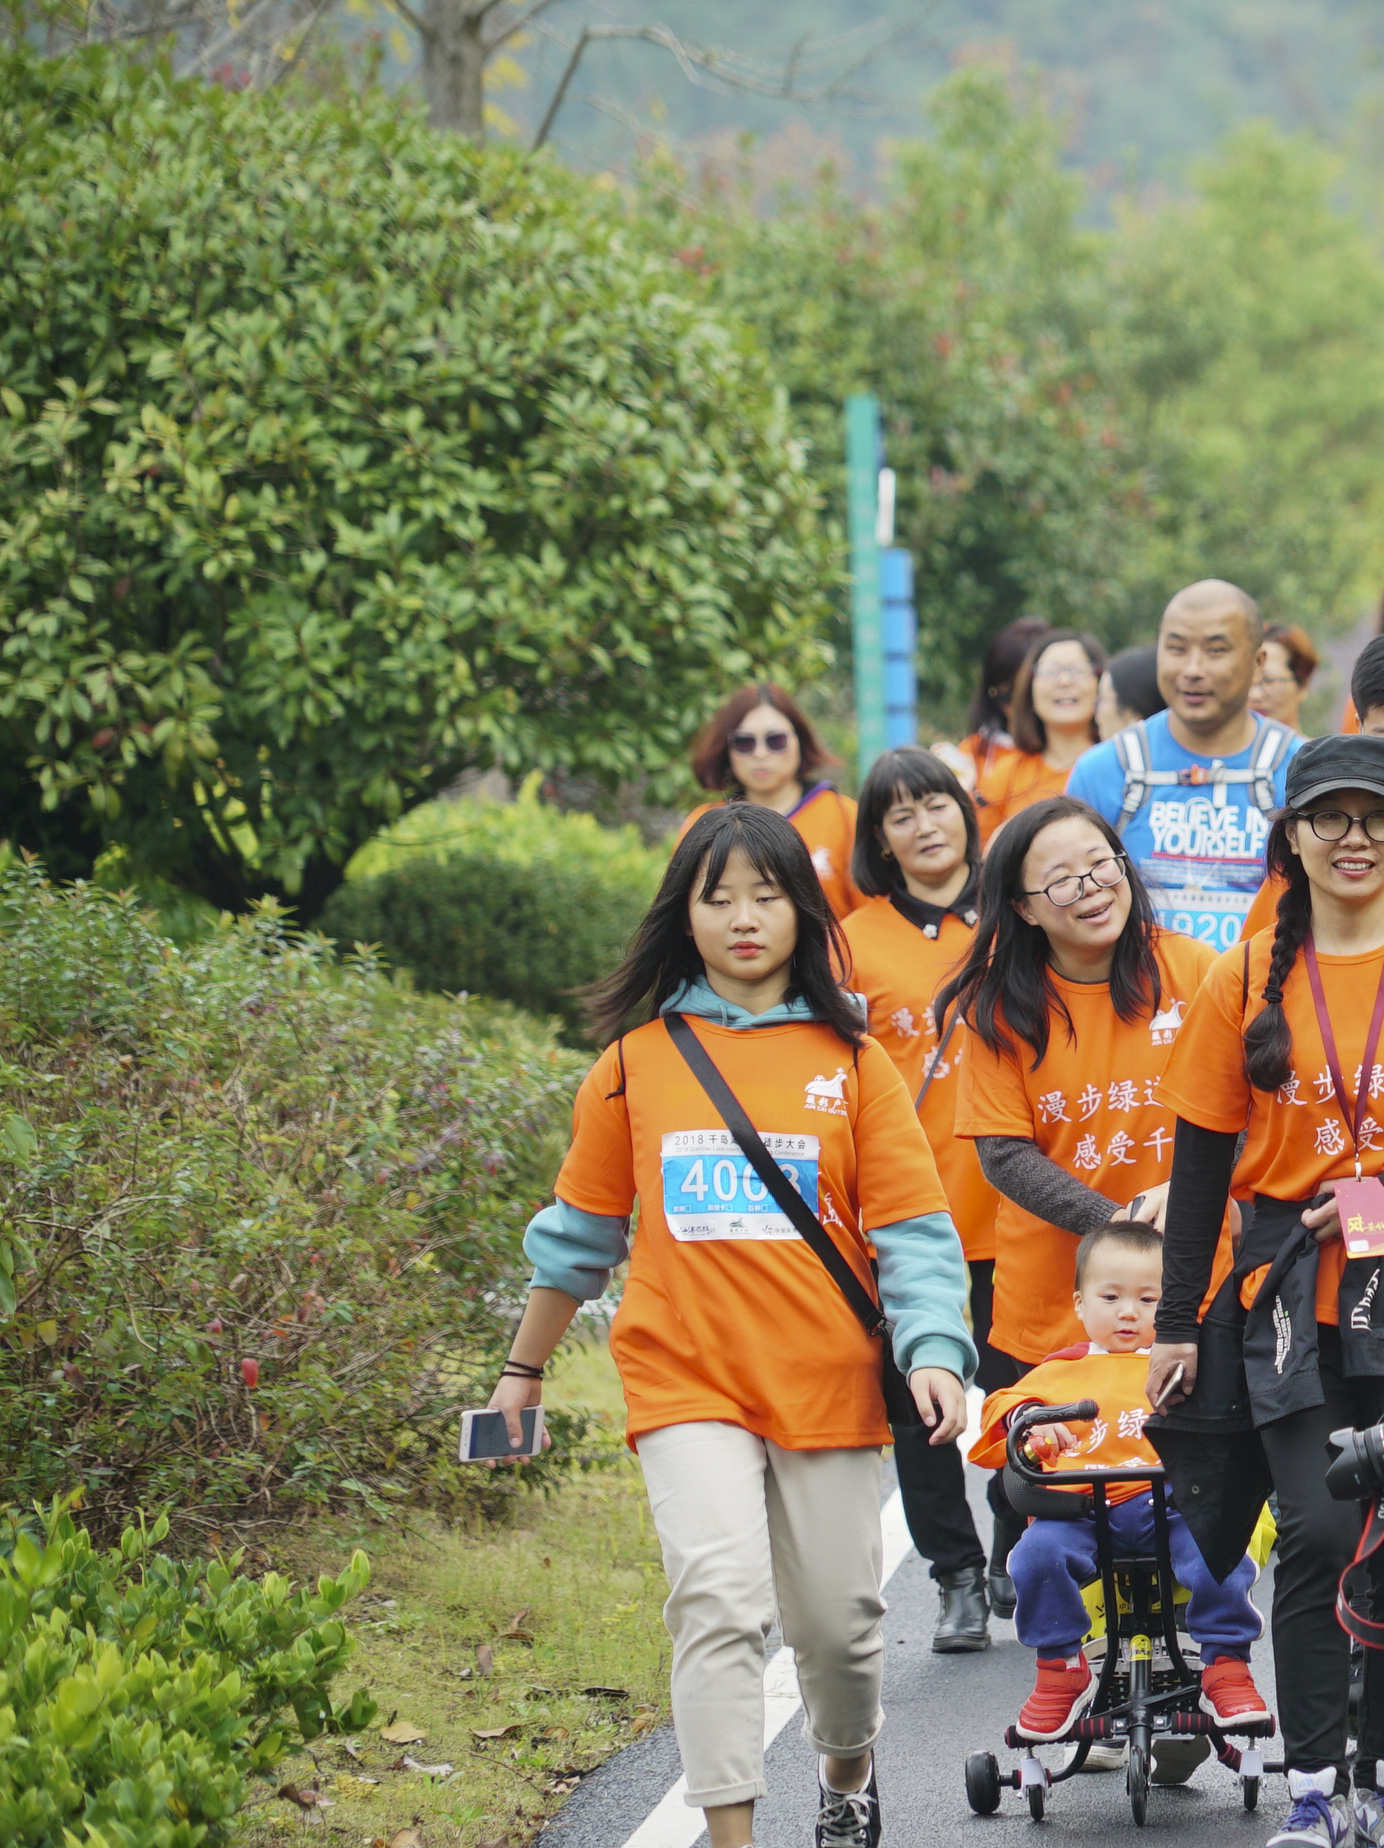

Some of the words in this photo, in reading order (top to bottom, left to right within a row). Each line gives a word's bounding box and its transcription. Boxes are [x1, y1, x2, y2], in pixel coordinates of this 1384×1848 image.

[1149, 801, 1240, 832] BELIEVE
[1152, 824, 1266, 858] YOURSELF
[675, 1135, 704, 1146] 2018
[1072, 1126, 1174, 1170] 感受千
